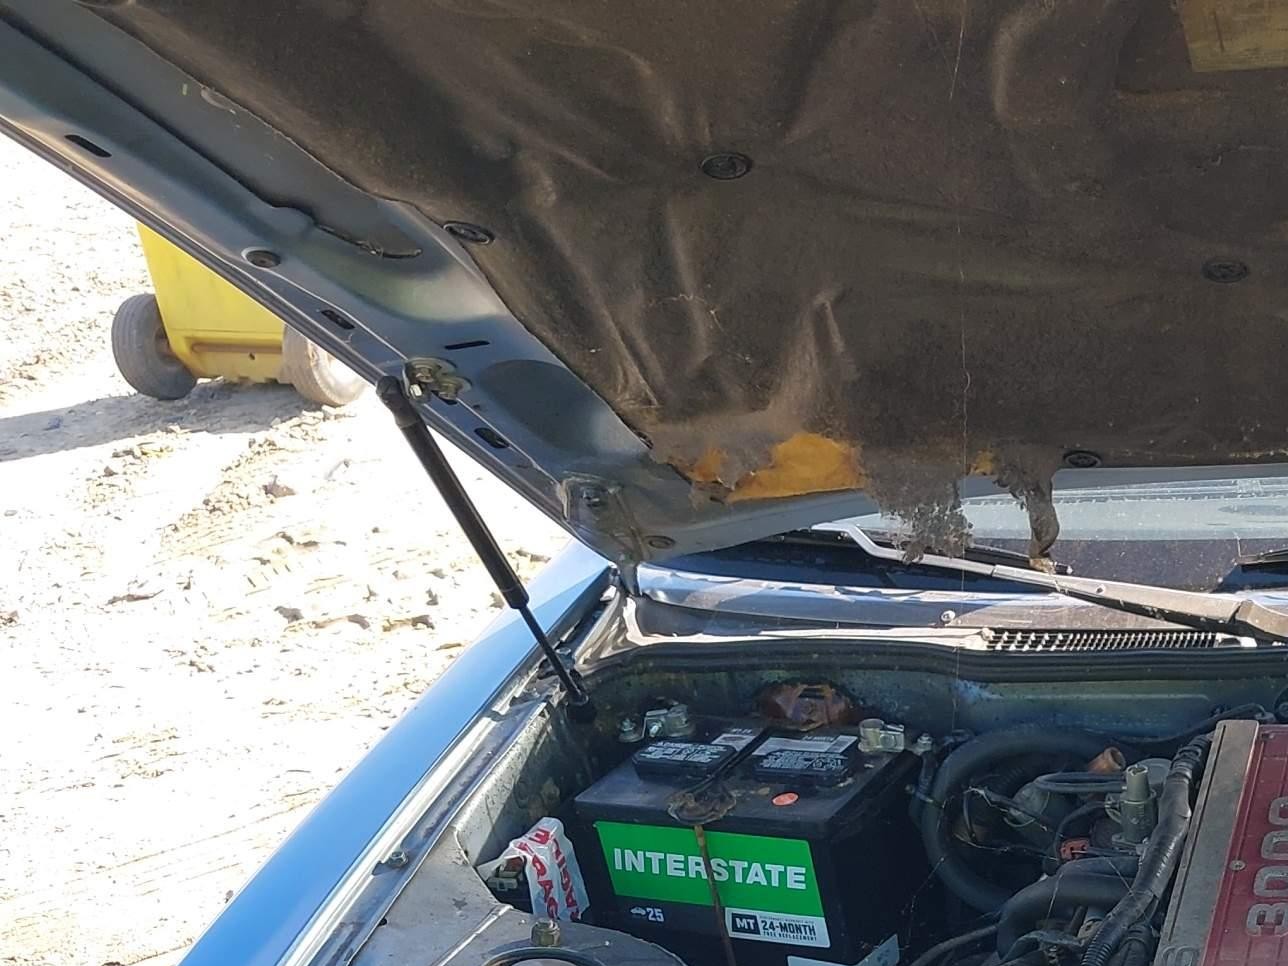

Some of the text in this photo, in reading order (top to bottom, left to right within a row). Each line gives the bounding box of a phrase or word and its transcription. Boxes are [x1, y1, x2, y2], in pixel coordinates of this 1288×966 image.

[613, 848, 807, 890] INTERSTATE
[646, 907, 665, 923] 25
[735, 917, 756, 931] MT
[761, 919, 817, 936] 24-MONTH
